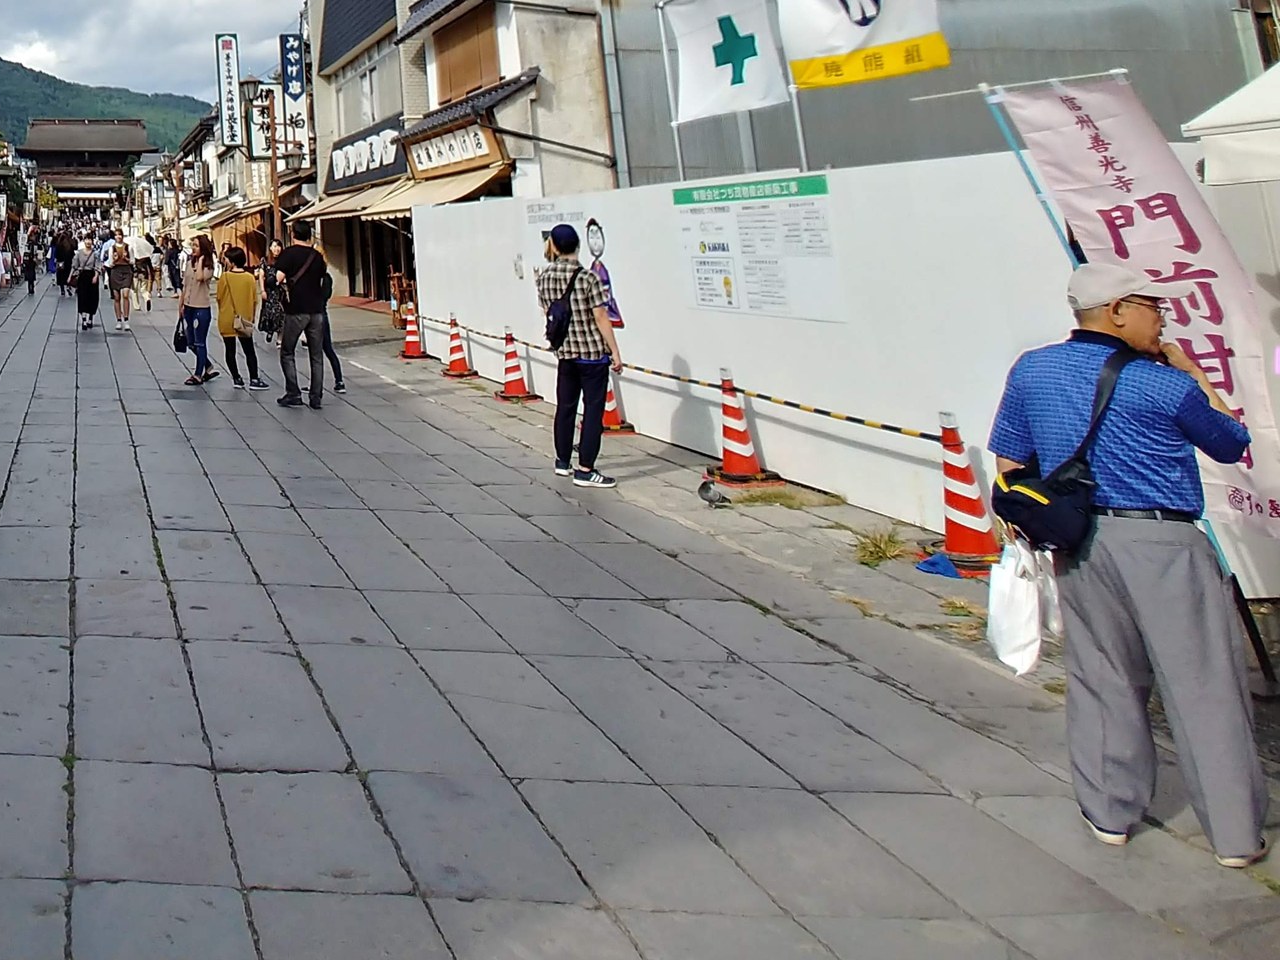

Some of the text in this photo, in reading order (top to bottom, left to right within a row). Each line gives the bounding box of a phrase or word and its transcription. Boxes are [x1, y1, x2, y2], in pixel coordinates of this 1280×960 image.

[1059, 95, 1135, 194] 信州善光寺
